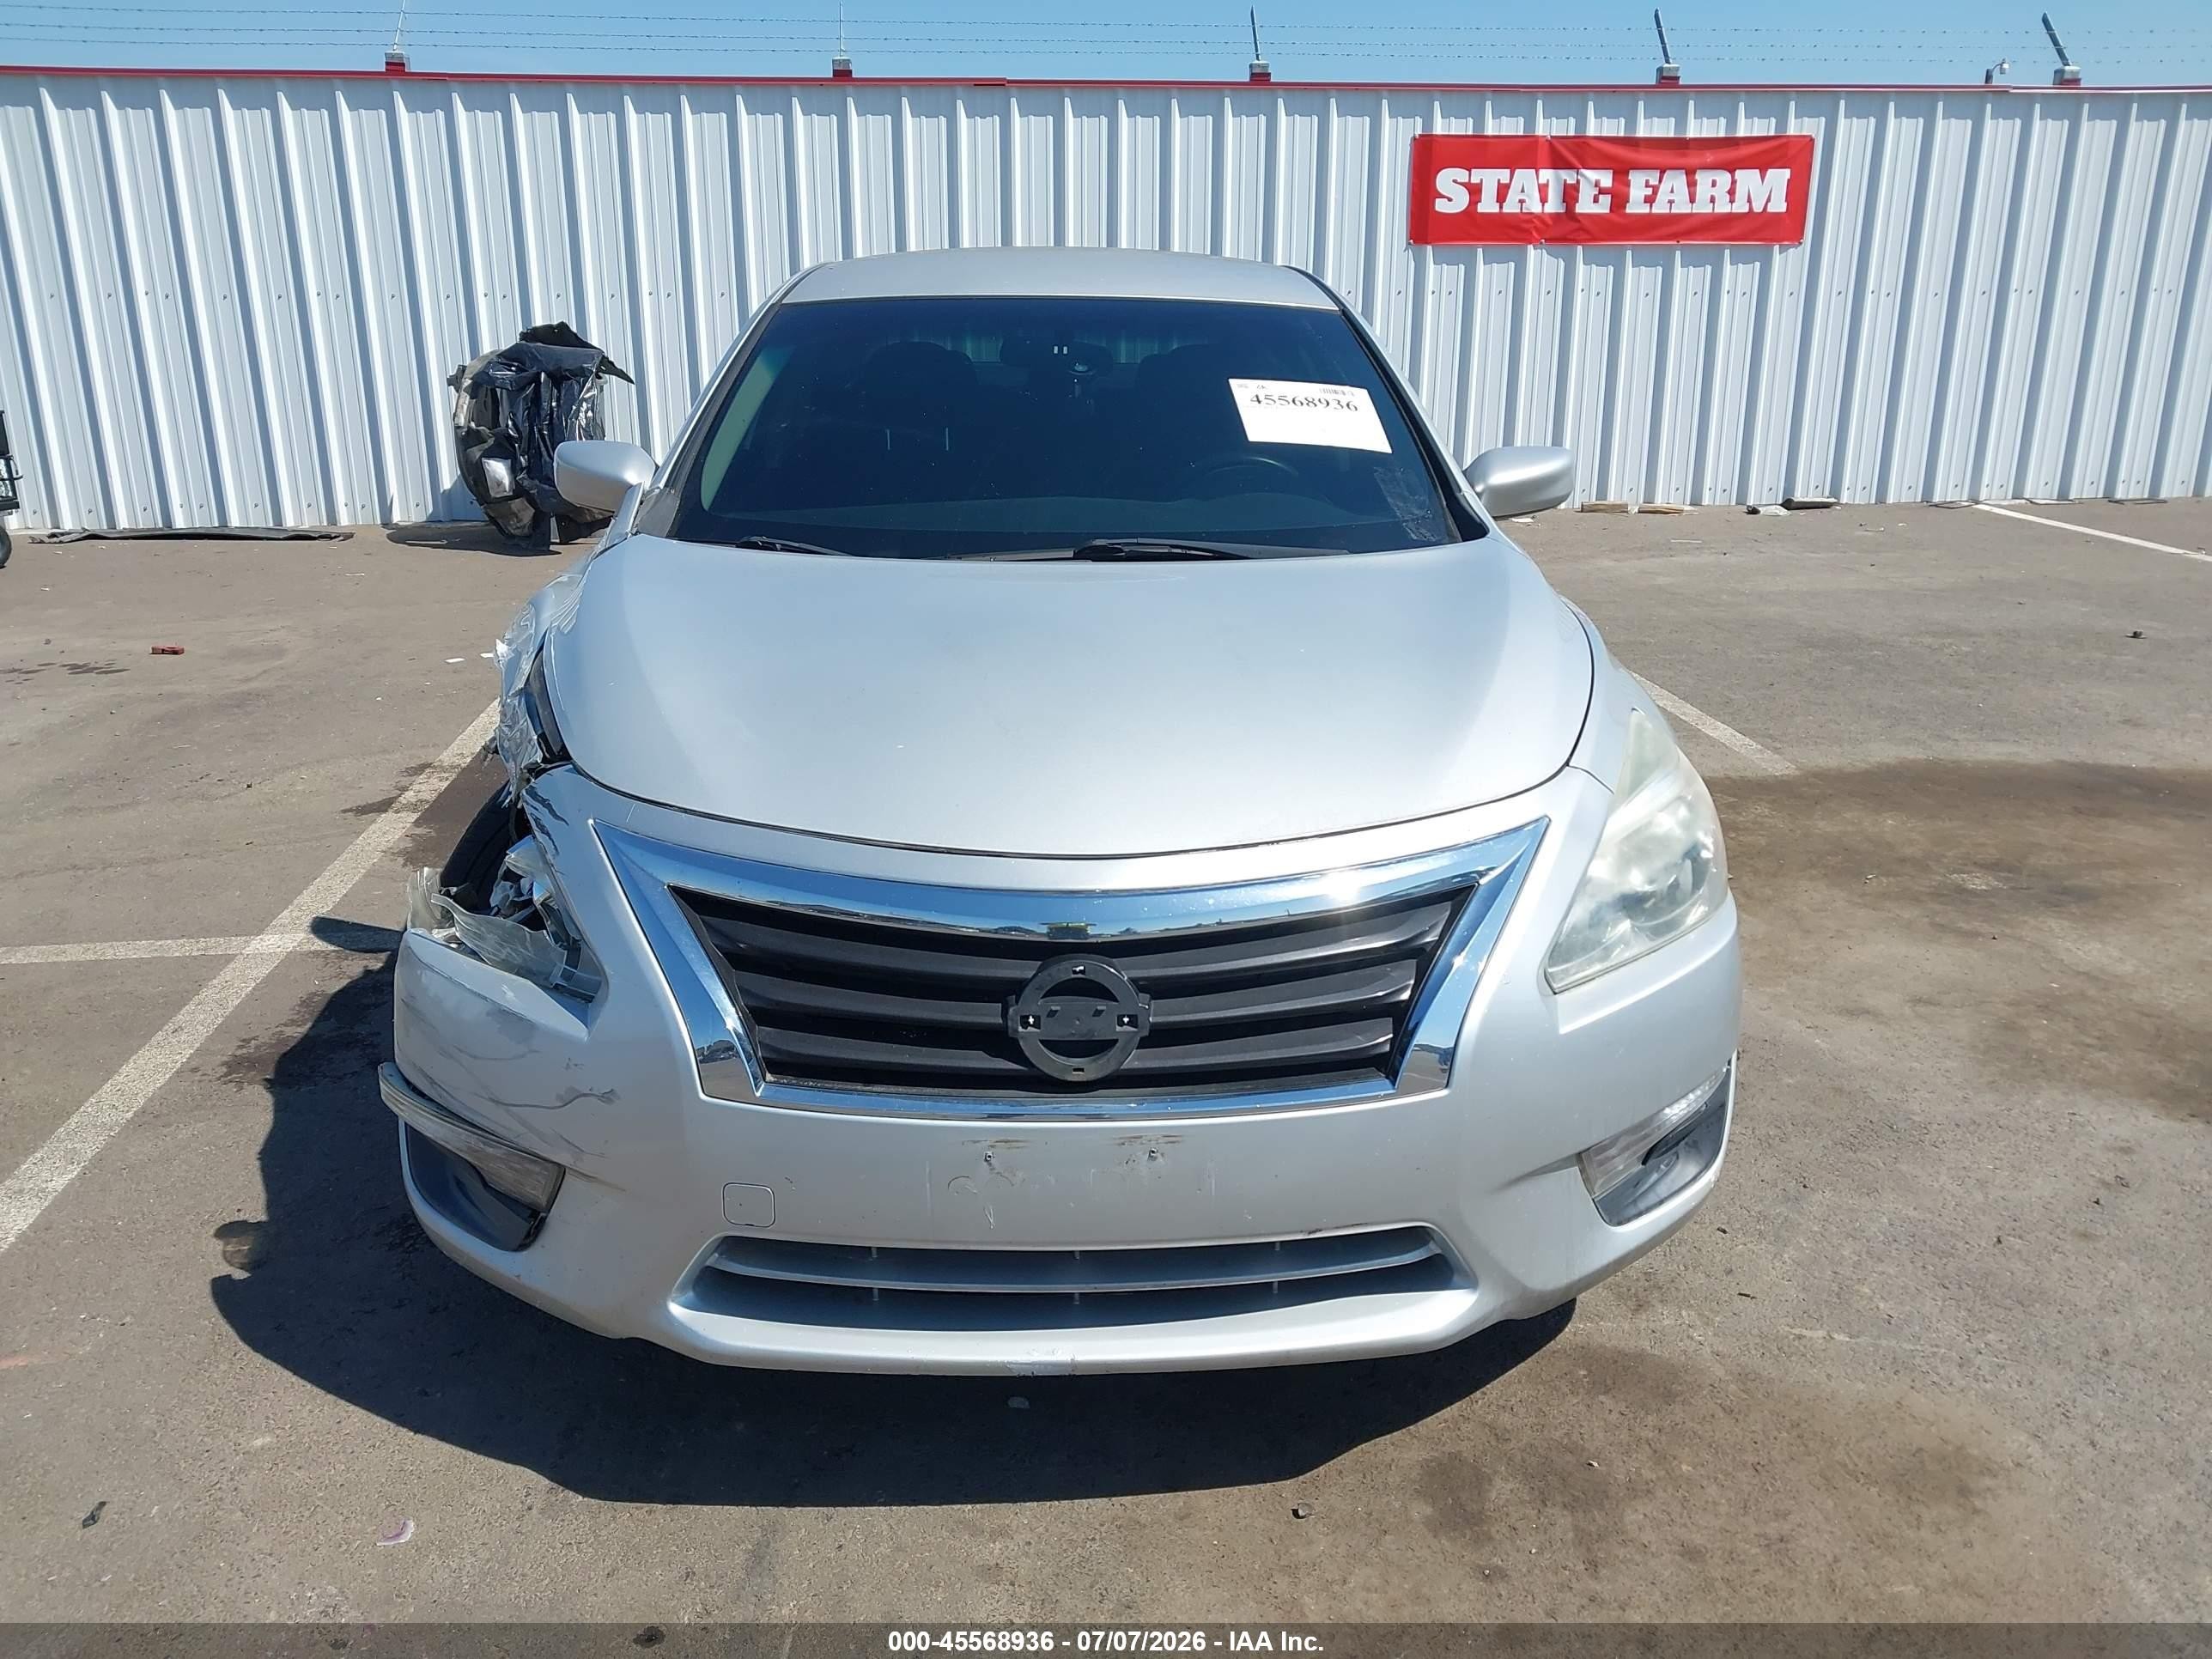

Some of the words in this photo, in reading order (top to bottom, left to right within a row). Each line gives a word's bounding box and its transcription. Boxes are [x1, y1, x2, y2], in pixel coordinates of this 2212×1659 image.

[1435, 167, 1613, 214] STATE
[1625, 167, 1791, 214] FARM
[1249, 393, 1358, 412] 45568936
